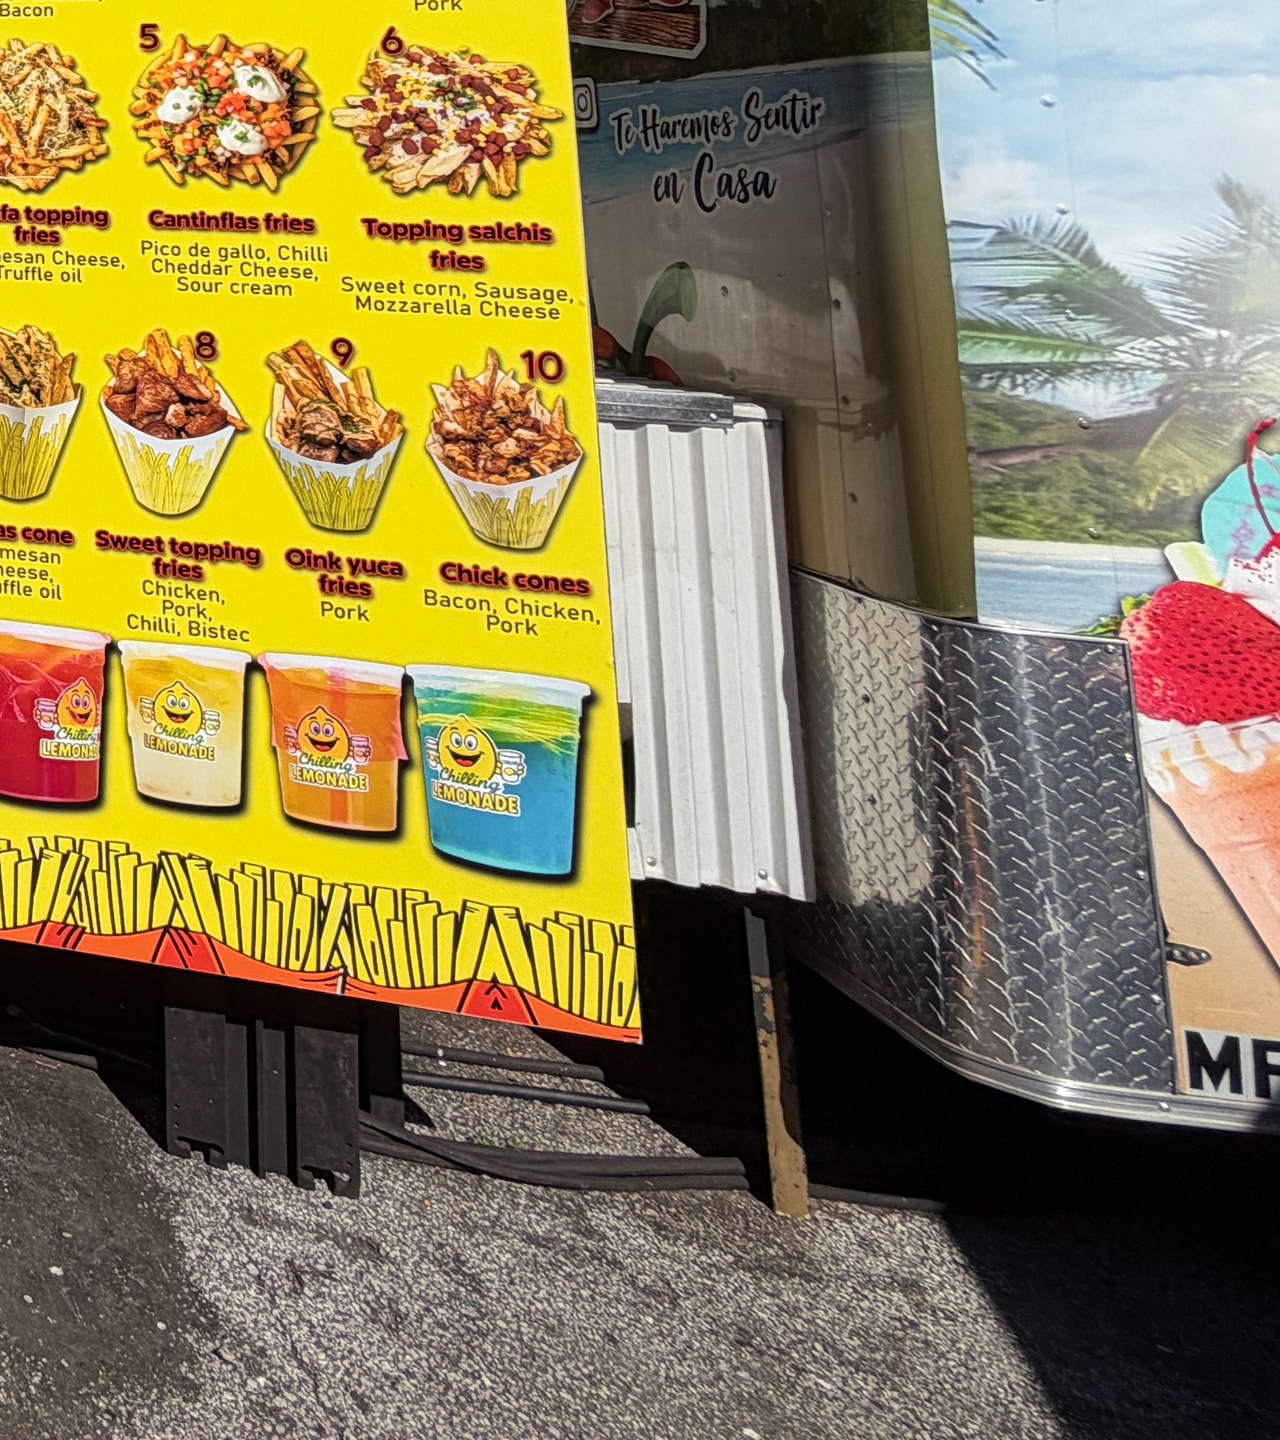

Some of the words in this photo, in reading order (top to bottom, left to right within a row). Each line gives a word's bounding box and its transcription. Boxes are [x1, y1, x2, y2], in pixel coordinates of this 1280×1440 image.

[0, 4, 54, 17] Bacon
[139, 23, 160, 51] 5
[380, 26, 404, 56] 6
[612, 112, 635, 150] Te
[640, 108, 733, 149] Haremos
[744, 91, 821, 142] Sentir
[654, 172, 684, 203] en
[695, 153, 776, 212] Casa
[23, 205, 110, 228] topping
[148, 209, 259, 232] Cantinflas
[263, 213, 316, 234] fries
[12, 225, 61, 245] fries
[361, 218, 465, 244] Topping
[469, 221, 553, 243] salchis
[52, 251, 126, 271] Cheese,
[140, 240, 181, 258] Pico
[188, 242, 211, 258] de
[218, 244, 271, 262] gallo,
[277, 245, 328, 263] Chilli
[429, 250, 485, 271] fries
[60, 268, 83, 284] oil
[151, 258, 233, 277] Cheddar
[239, 262, 319, 282] Cheese,
[177, 277, 222, 294] Sour
[230, 281, 293, 297] cream
[341, 276, 405, 294] Sweet
[413, 282, 467, 299] corn,
[474, 282, 574, 304] Sausage,
[355, 295, 471, 316] Mozzarella
[480, 301, 561, 320] Cheese
[194, 331, 217, 360] 8
[330, 337, 354, 367] 9
[520, 350, 564, 383] 10
[21, 525, 74, 546] cone
[95, 529, 166, 554] Sweet
[170, 536, 262, 566] topping
[152, 557, 204, 581] fries
[284, 547, 343, 573] Oink
[346, 556, 405, 580] yuca
[317, 574, 373, 599] fries
[440, 561, 508, 588] Chick
[512, 571, 591, 596] cones
[39, 583, 62, 601] oil
[142, 580, 226, 606] Chicken,
[162, 600, 212, 621] Pork,
[321, 601, 370, 622] Pork
[424, 589, 498, 615] Bacon,
[505, 597, 601, 626] Chicken,
[127, 614, 181, 638] Chilli,
[188, 621, 250, 642] Bistec
[487, 615, 539, 636] Pork
[153, 723, 205, 744] Chilling
[144, 733, 215, 760] LEMONADE
[299, 752, 354, 772] Chilling
[290, 764, 368, 790] LEMONADE
[439, 768, 501, 792] Chilling
[432, 780, 519, 814] LEMONADE
